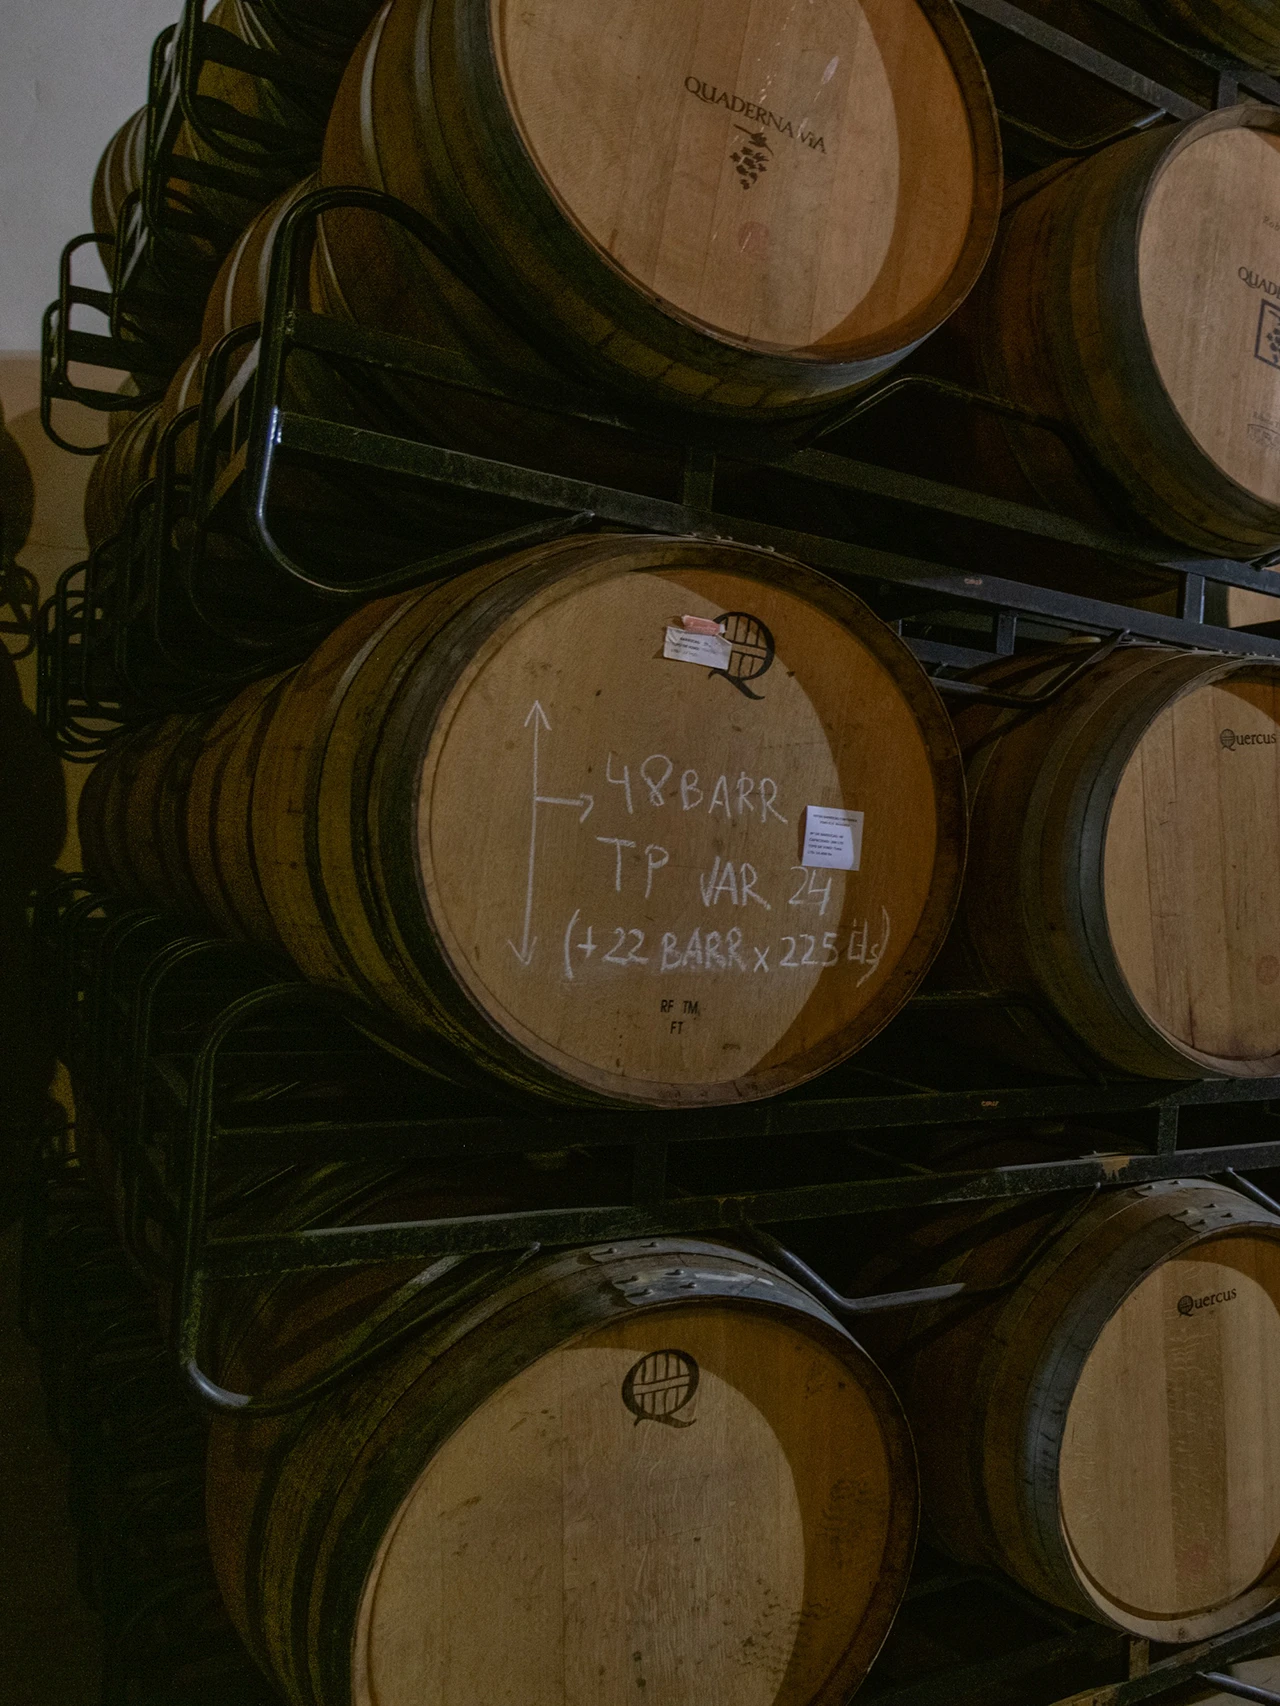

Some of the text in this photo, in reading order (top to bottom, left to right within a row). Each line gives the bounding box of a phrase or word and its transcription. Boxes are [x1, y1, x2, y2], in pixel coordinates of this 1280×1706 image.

[684, 76, 794, 139] QUADERNA
[1220, 728, 1277, 751] Quercus
[788, 865, 832, 917] 24
[780, 931, 839, 968] 225
[1177, 1287, 1237, 1317] Quercus
